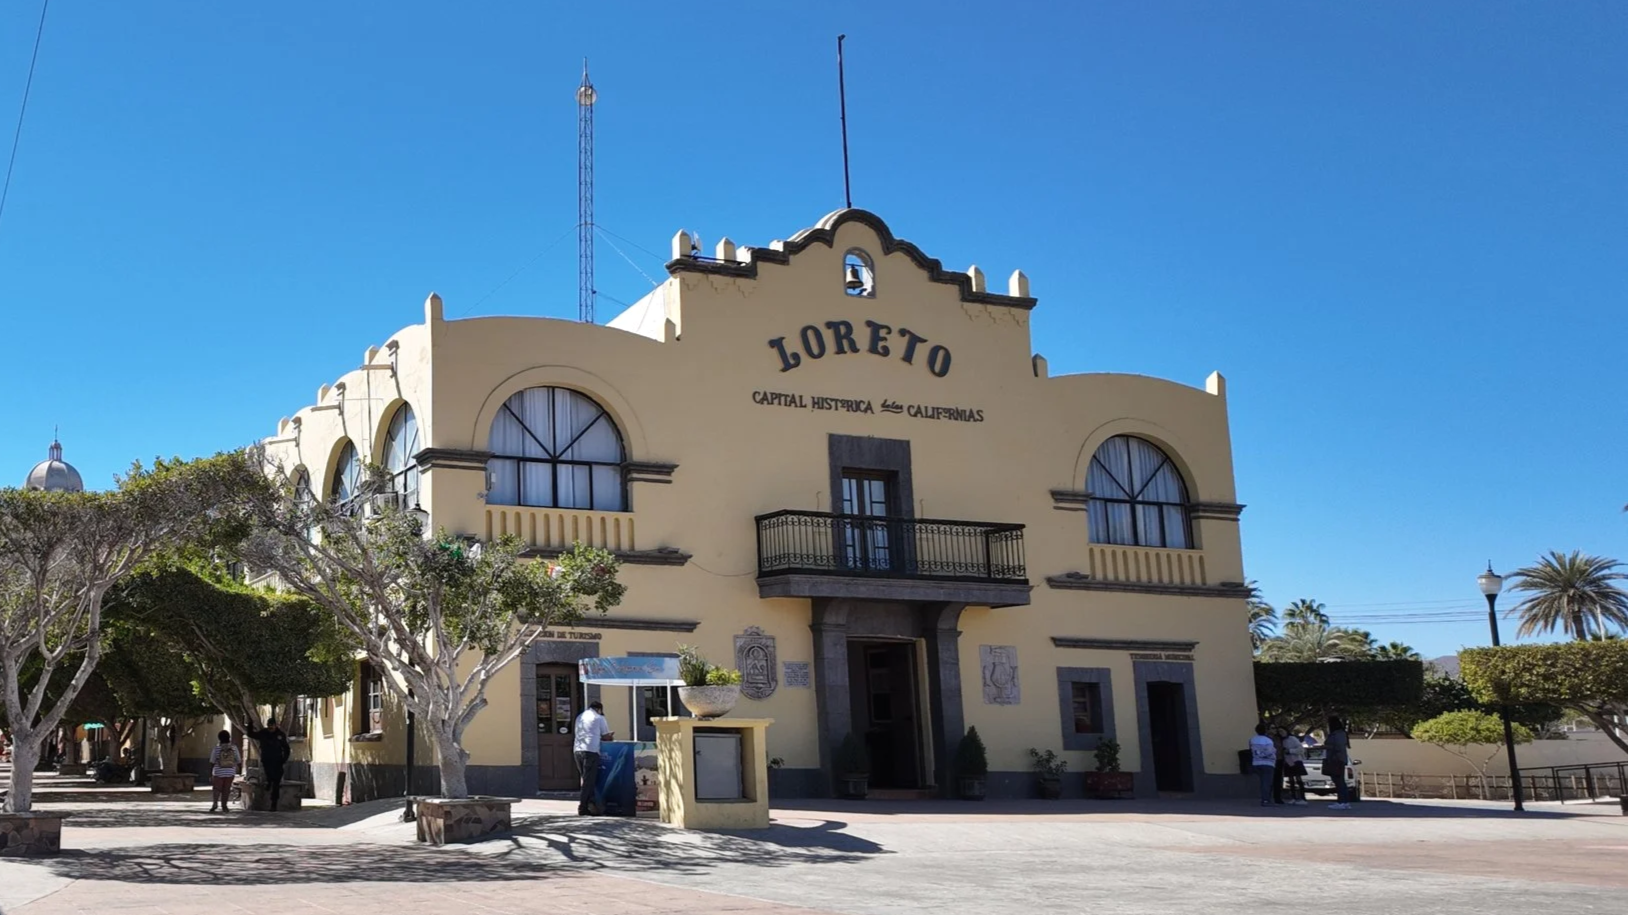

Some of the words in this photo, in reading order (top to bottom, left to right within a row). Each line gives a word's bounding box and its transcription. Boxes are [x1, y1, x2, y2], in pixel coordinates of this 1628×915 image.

[768, 319, 952, 378] LORETO
[752, 390, 807, 408] CAPITAL
[907, 404, 985, 422] CALIFORNIAS
[568, 631, 602, 640] TURISMO
